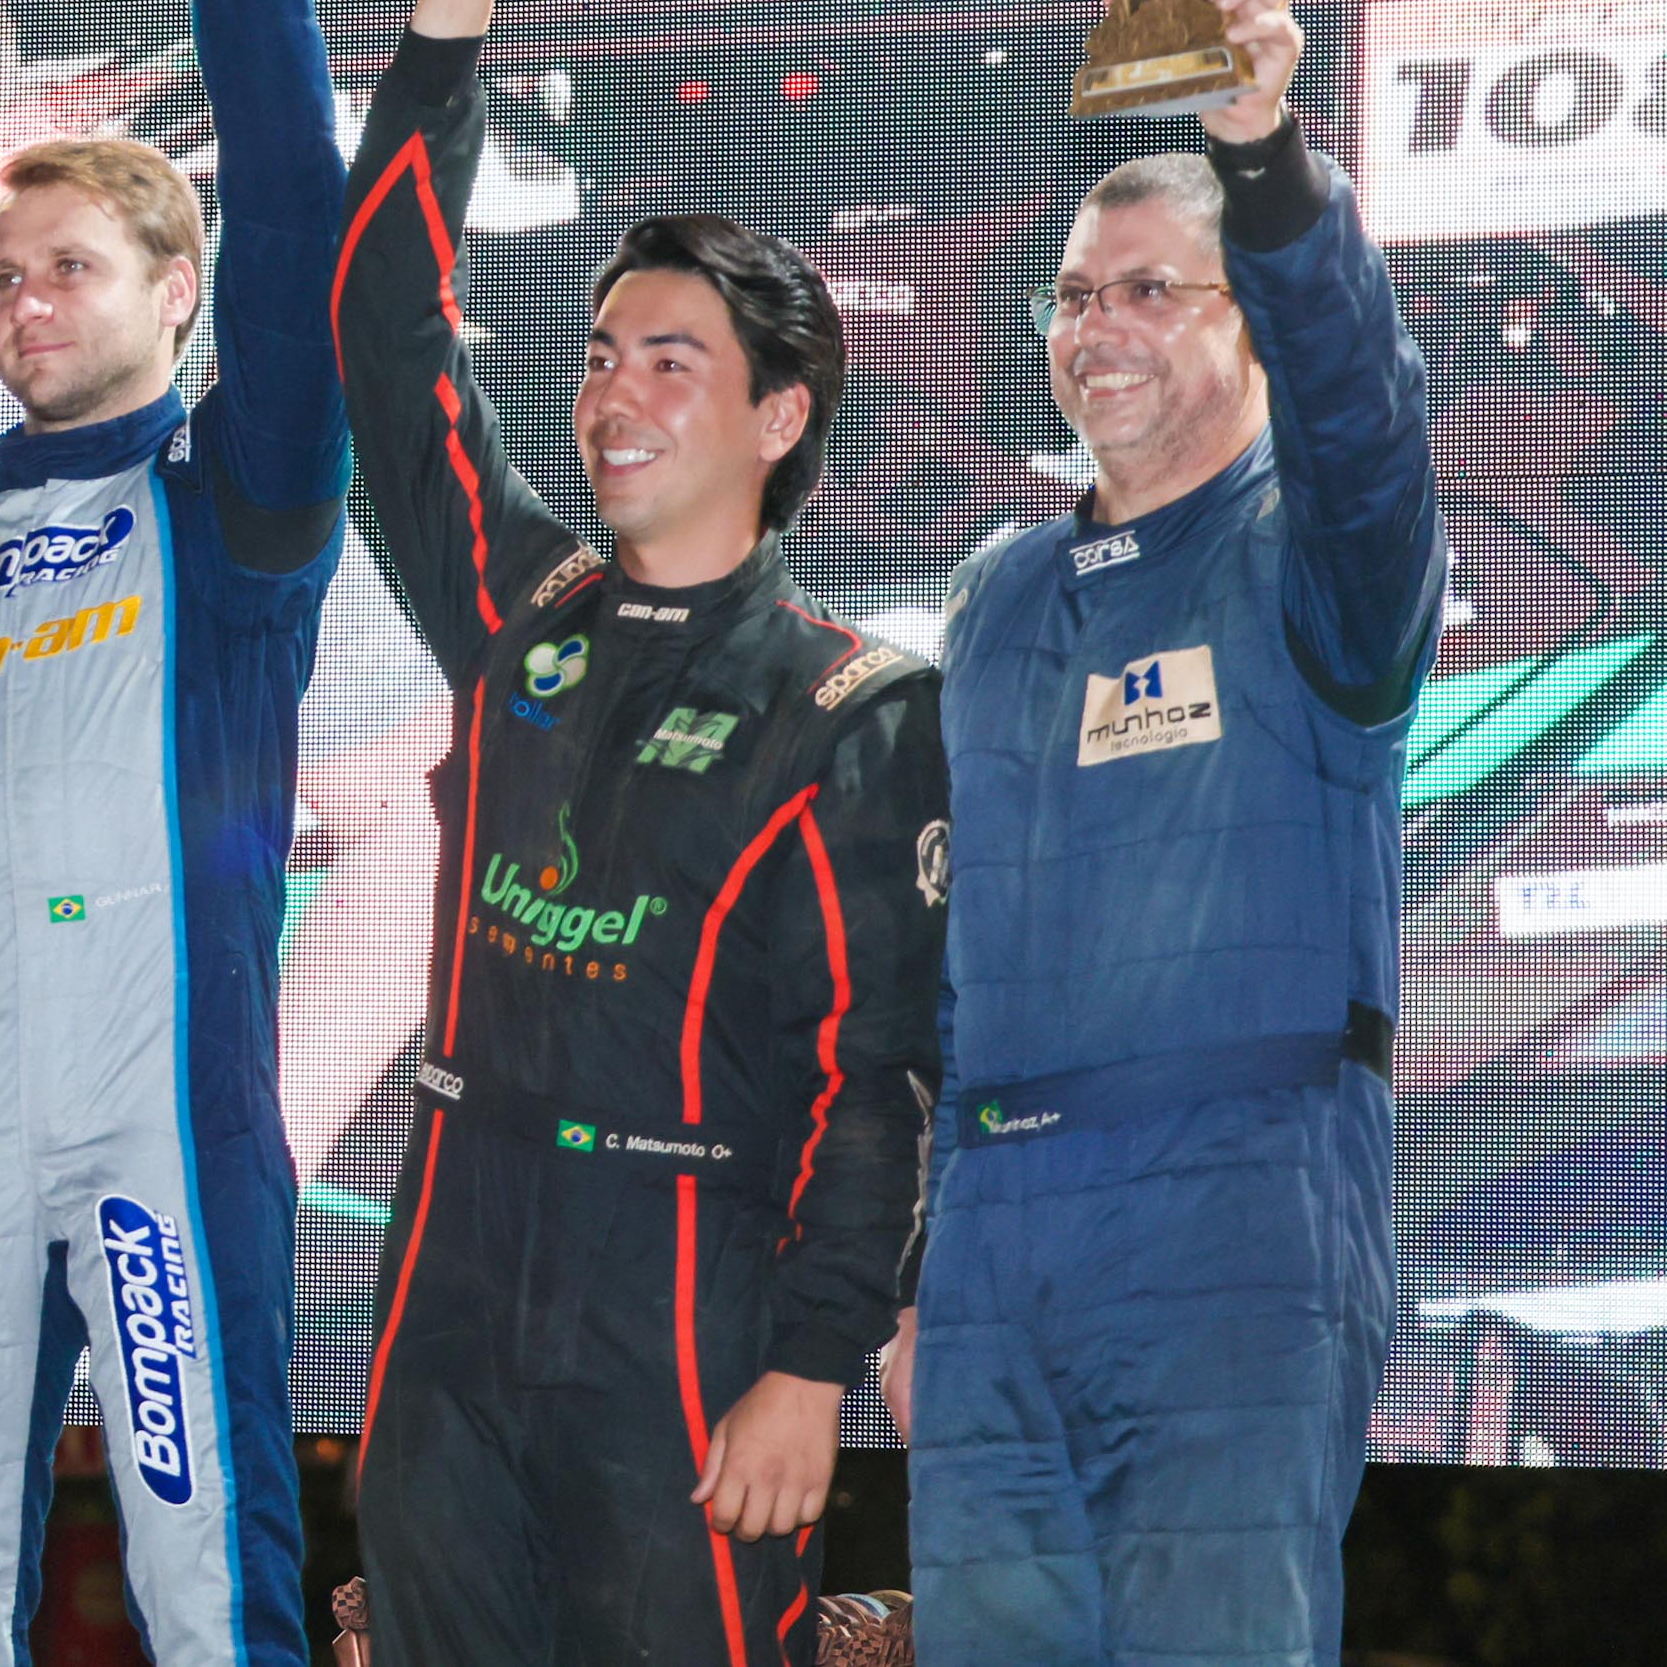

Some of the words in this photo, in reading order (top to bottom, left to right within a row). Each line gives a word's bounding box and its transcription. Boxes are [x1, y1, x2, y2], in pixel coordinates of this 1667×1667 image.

[1398, 47, 1667, 157] 10
[616, 601, 691, 624] can-am
[814, 646, 897, 709] sparco
[1086, 701, 1212, 744] munhoz
[604, 1134, 621, 1149] C.
[625, 1135, 706, 1158] Matsumoto
[158, 1213, 197, 1358] RACING
[103, 1220, 182, 1477] Bompack
